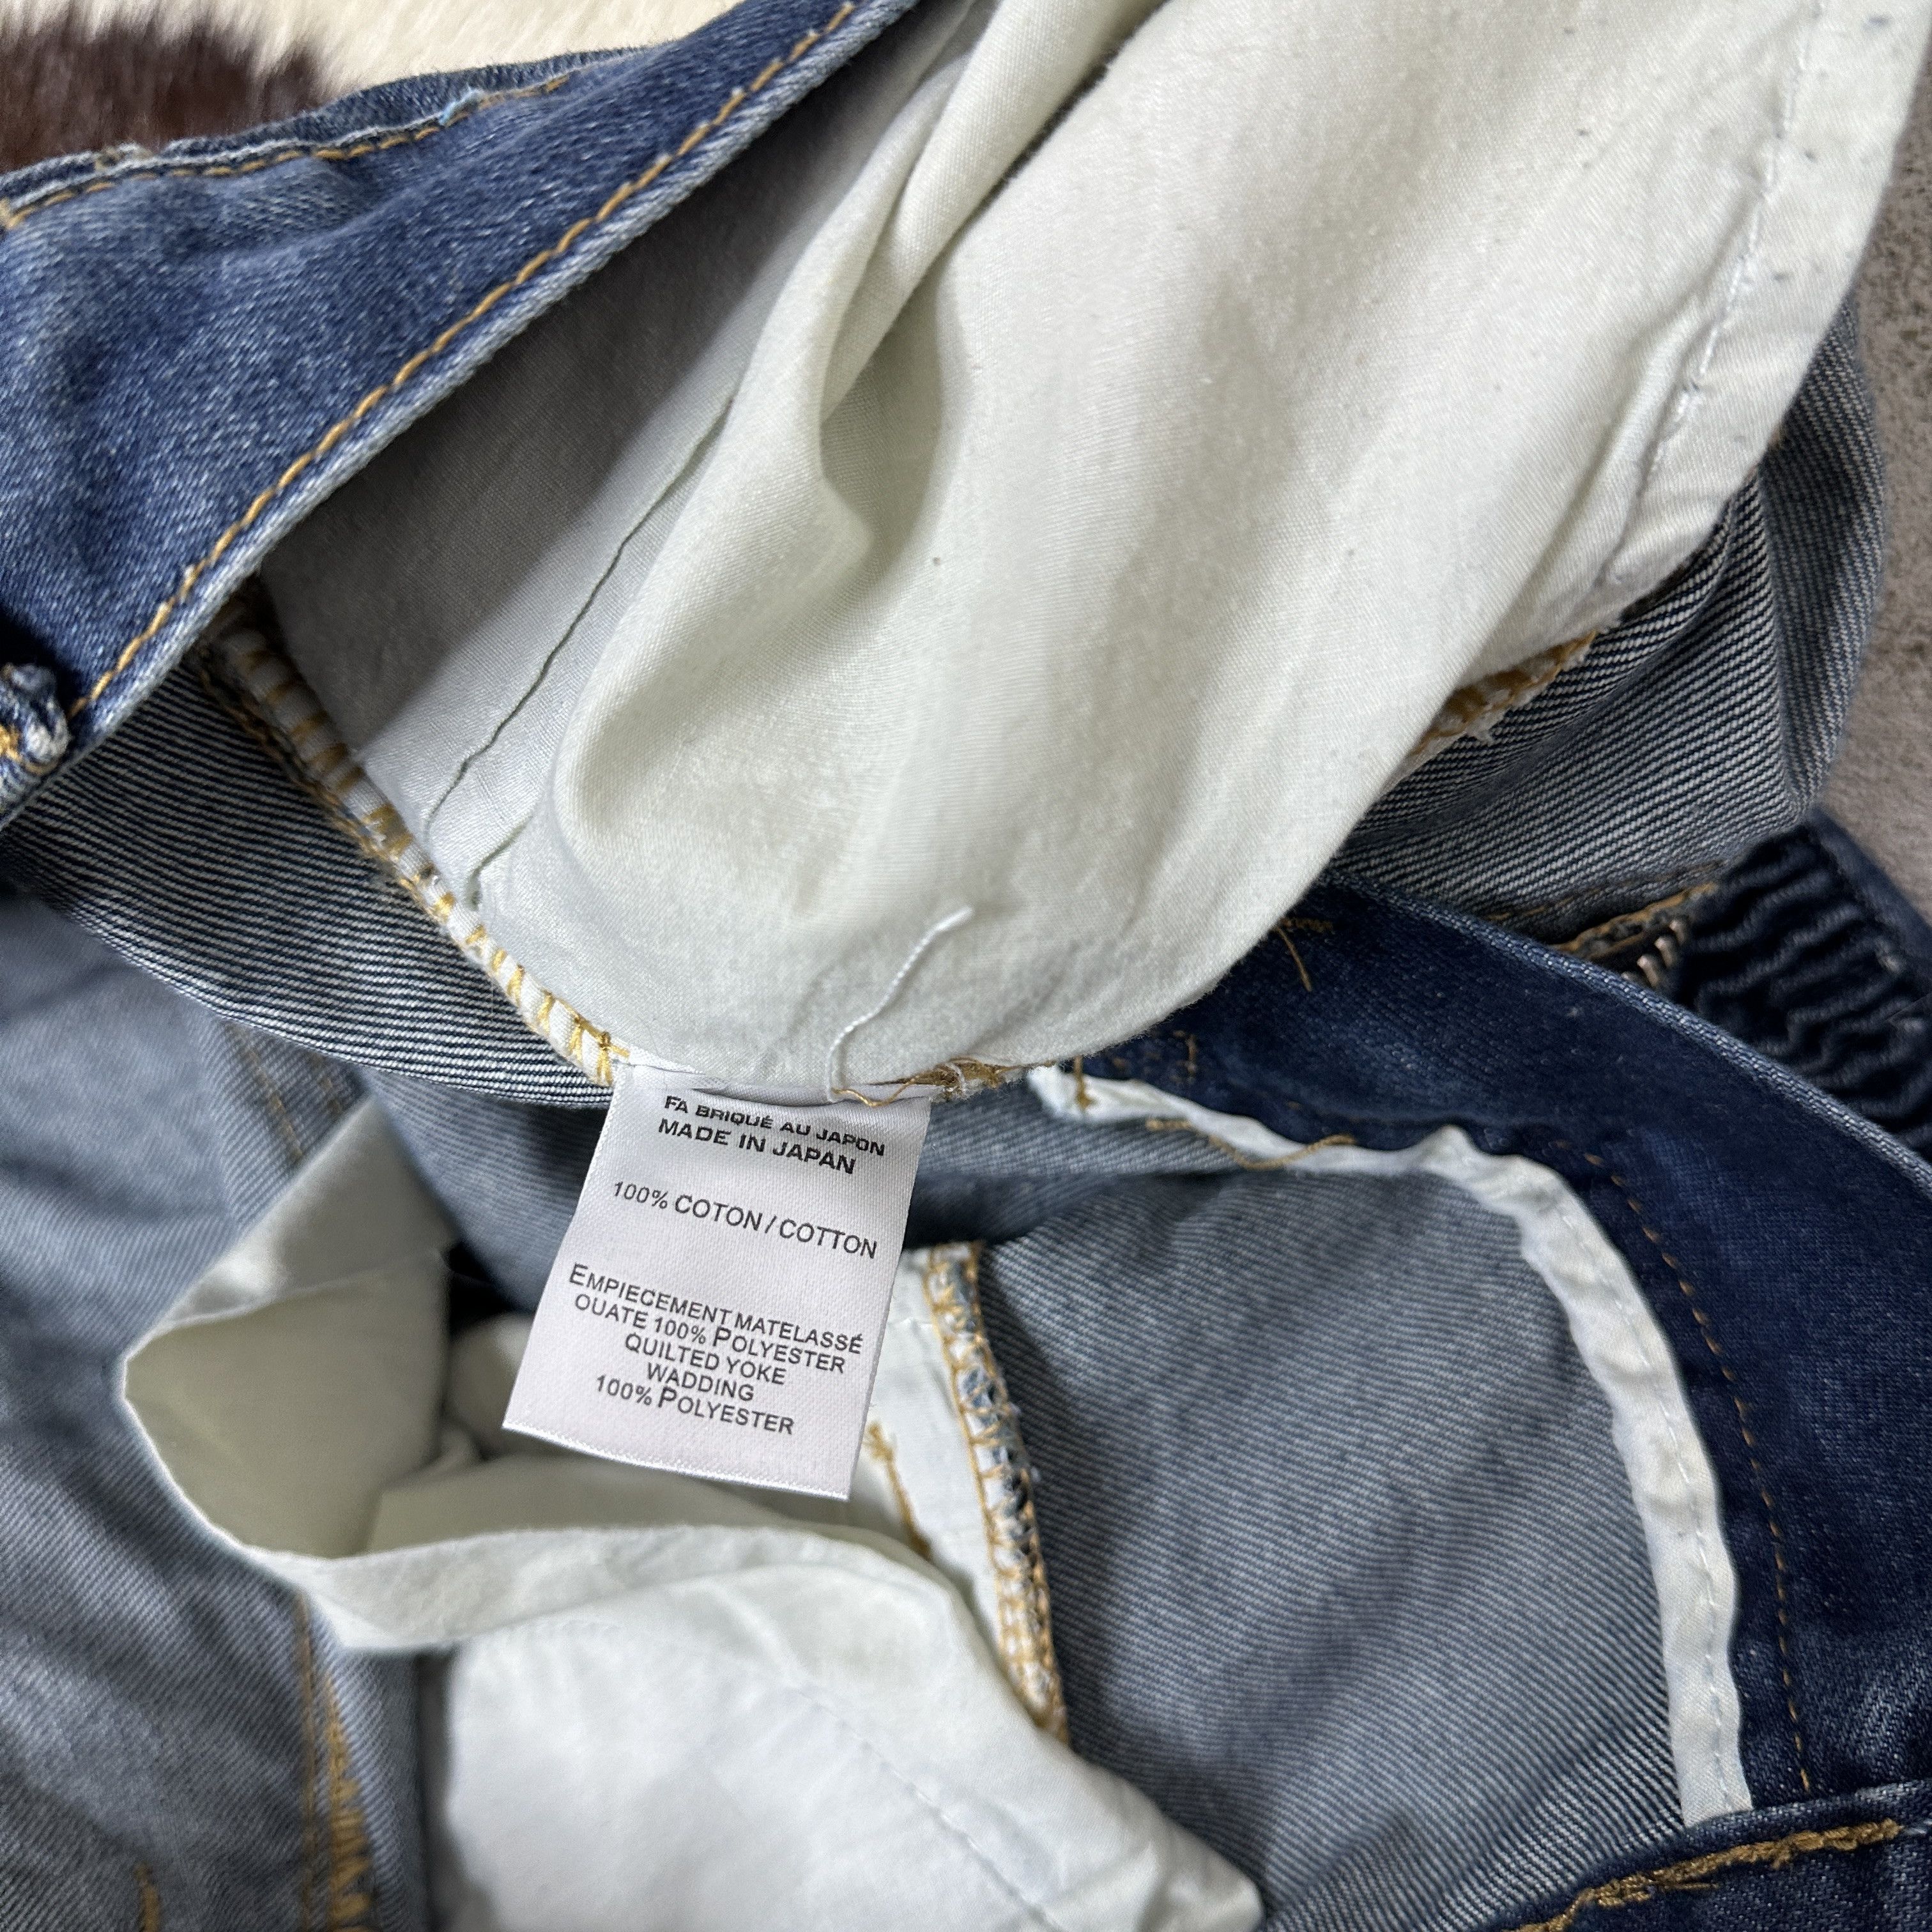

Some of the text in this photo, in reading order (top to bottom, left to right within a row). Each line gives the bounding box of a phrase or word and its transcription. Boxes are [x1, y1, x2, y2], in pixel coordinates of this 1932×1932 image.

[659, 1118, 856, 1174] MADE IN JAPAN
[779, 1121, 811, 1137] AU
[816, 1128, 885, 1156] JAPON
[614, 1180, 668, 1209] 100%
[575, 1293, 647, 1330] OUATE
[654, 1316, 707, 1344] 100%
[735, 1314, 864, 1355] MATELASSÉ
[625, 1331, 787, 1386] QUILTED YOKE
[595, 1375, 653, 1407] 100%
[647, 1362, 755, 1402] WADDING
